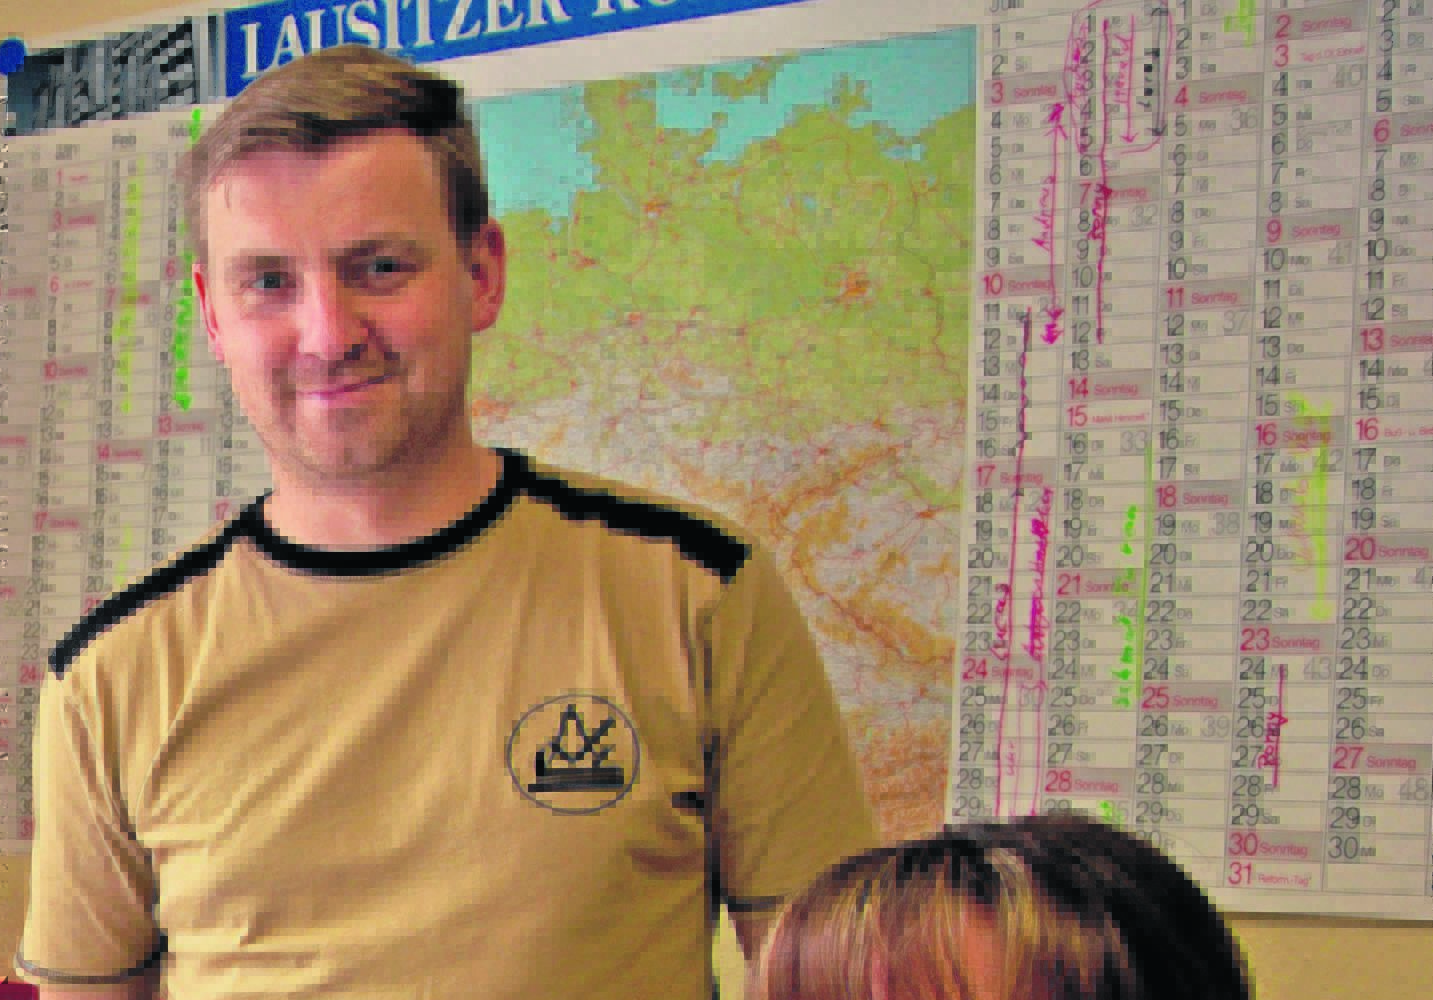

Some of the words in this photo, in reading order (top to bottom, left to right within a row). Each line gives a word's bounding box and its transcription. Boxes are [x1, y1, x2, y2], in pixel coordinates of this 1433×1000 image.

[1276, 14, 1291, 39] 2
[1302, 17, 1352, 32] Sonntag
[1380, 29, 1394, 52] 3
[992, 54, 1004, 76] 2
[1274, 44, 1289, 67] 3
[991, 82, 1004, 104] 3
[1014, 85, 1057, 98] Sonntag
[1174, 85, 1189, 107] 4
[1200, 90, 1248, 103] Sonntag
[1374, 118, 1390, 143] 6
[990, 164, 1001, 185] 6
[991, 191, 1000, 213] 7
[1079, 182, 1091, 204] 7
[1270, 191, 1281, 213] 8
[1078, 211, 1089, 232] 8
[1132, 206, 1158, 227] 32
[1172, 201, 1184, 223] 8
[1370, 208, 1384, 232] 9
[988, 219, 1000, 240] 8
[1171, 230, 1183, 251] 9
[1267, 219, 1281, 242] 9
[1292, 224, 1341, 238] Sonntag
[987, 248, 1000, 268] 9
[1077, 239, 1088, 260] 9
[1264, 248, 1285, 270] 10
[1365, 238, 1388, 261] 10
[1073, 266, 1093, 287] 10
[1167, 258, 1187, 279] 10
[982, 272, 1003, 295] 10
[1264, 279, 1280, 299] 11
[1365, 270, 1384, 291] 11
[1073, 296, 1088, 315] 11
[1167, 288, 1184, 308] 11
[1192, 291, 1238, 304] Sonntag
[1261, 307, 1281, 328] 12
[1362, 298, 1384, 321] 12
[1072, 321, 1091, 344] 12
[1165, 315, 1184, 336] 12
[1224, 310, 1249, 334] 37
[1359, 327, 1384, 351] 13
[1256, 366, 1279, 387] 14
[1359, 358, 1382, 381] 14
[981, 384, 998, 402] 14
[1069, 377, 1088, 398] 14
[1094, 384, 1138, 396] Sonntag
[1256, 394, 1278, 416] 15
[1358, 388, 1381, 410] 15
[980, 410, 998, 431] 15
[1068, 405, 1088, 427] 15
[1160, 400, 1181, 421] 15
[1160, 428, 1179, 449] 16
[1256, 422, 1276, 446] 16
[1356, 417, 1379, 440] 16
[1067, 433, 1087, 454] 16
[1121, 431, 1147, 452] 33
[1159, 457, 1176, 479] 17
[1255, 452, 1274, 474] 17
[1354, 450, 1377, 473] 17
[977, 464, 996, 486] 17
[1065, 488, 1083, 510] 18
[1157, 485, 1176, 508] 18
[1183, 492, 1228, 506] Sonntag
[1353, 477, 1376, 500] 18
[1156, 514, 1175, 536] 19
[1213, 513, 1240, 535] 38
[968, 548, 993, 568] 20
[1057, 546, 1083, 568] 20
[1150, 543, 1176, 565] 20
[1246, 540, 1273, 562] 20
[1346, 537, 1375, 561] 20
[1379, 545, 1429, 560] Sonntag
[968, 576, 991, 596] 21
[1057, 574, 1080, 597] 21
[1150, 572, 1172, 593] 21
[1246, 569, 1271, 592] 21
[1346, 568, 1371, 590] 21
[967, 602, 992, 624] 22
[1056, 602, 1081, 624] 22
[1147, 600, 1173, 622] 22
[1242, 600, 1271, 621] 22
[1343, 597, 1373, 620] 22
[965, 631, 990, 651] 23
[1055, 630, 1080, 651] 23
[1146, 629, 1172, 651] 23
[1241, 628, 1269, 650] 23
[1272, 636, 1320, 650] Sonntag
[1341, 627, 1371, 650] 23
[963, 658, 987, 680] 24
[1053, 658, 1077, 679] 24
[1145, 658, 1168, 679] 24
[1240, 657, 1265, 680] 24
[1303, 657, 1331, 680] 43
[1340, 657, 1367, 680] 24
[961, 686, 985, 707] 25
[1050, 686, 1073, 708] 25
[1142, 686, 1169, 708] 25
[1174, 696, 1218, 709] Sonntag
[1239, 687, 1265, 709] 25
[960, 713, 985, 735] 26
[1048, 714, 1075, 736] 26
[1141, 715, 1168, 736] 26
[1201, 715, 1229, 737] 39
[1236, 716, 1264, 738] 26
[959, 741, 984, 762] 27
[1048, 743, 1072, 764] 27
[1139, 744, 1164, 765] 27
[1333, 746, 1364, 769] 27
[1366, 755, 1416, 769] Sonntag
[957, 768, 983, 790] 28
[1045, 770, 1072, 792] 28
[1074, 780, 1119, 793] Sonntag
[1137, 772, 1164, 794] 28
[1233, 775, 1260, 797] 28
[1332, 776, 1361, 800] 28
[953, 796, 982, 817] 29
[1136, 801, 1163, 824] 29
[1232, 804, 1260, 826] 29
[1228, 832, 1258, 857] 30
[1259, 842, 1308, 857] Sonntag
[1328, 836, 1359, 859] 30
[1228, 862, 1253, 885] 31
